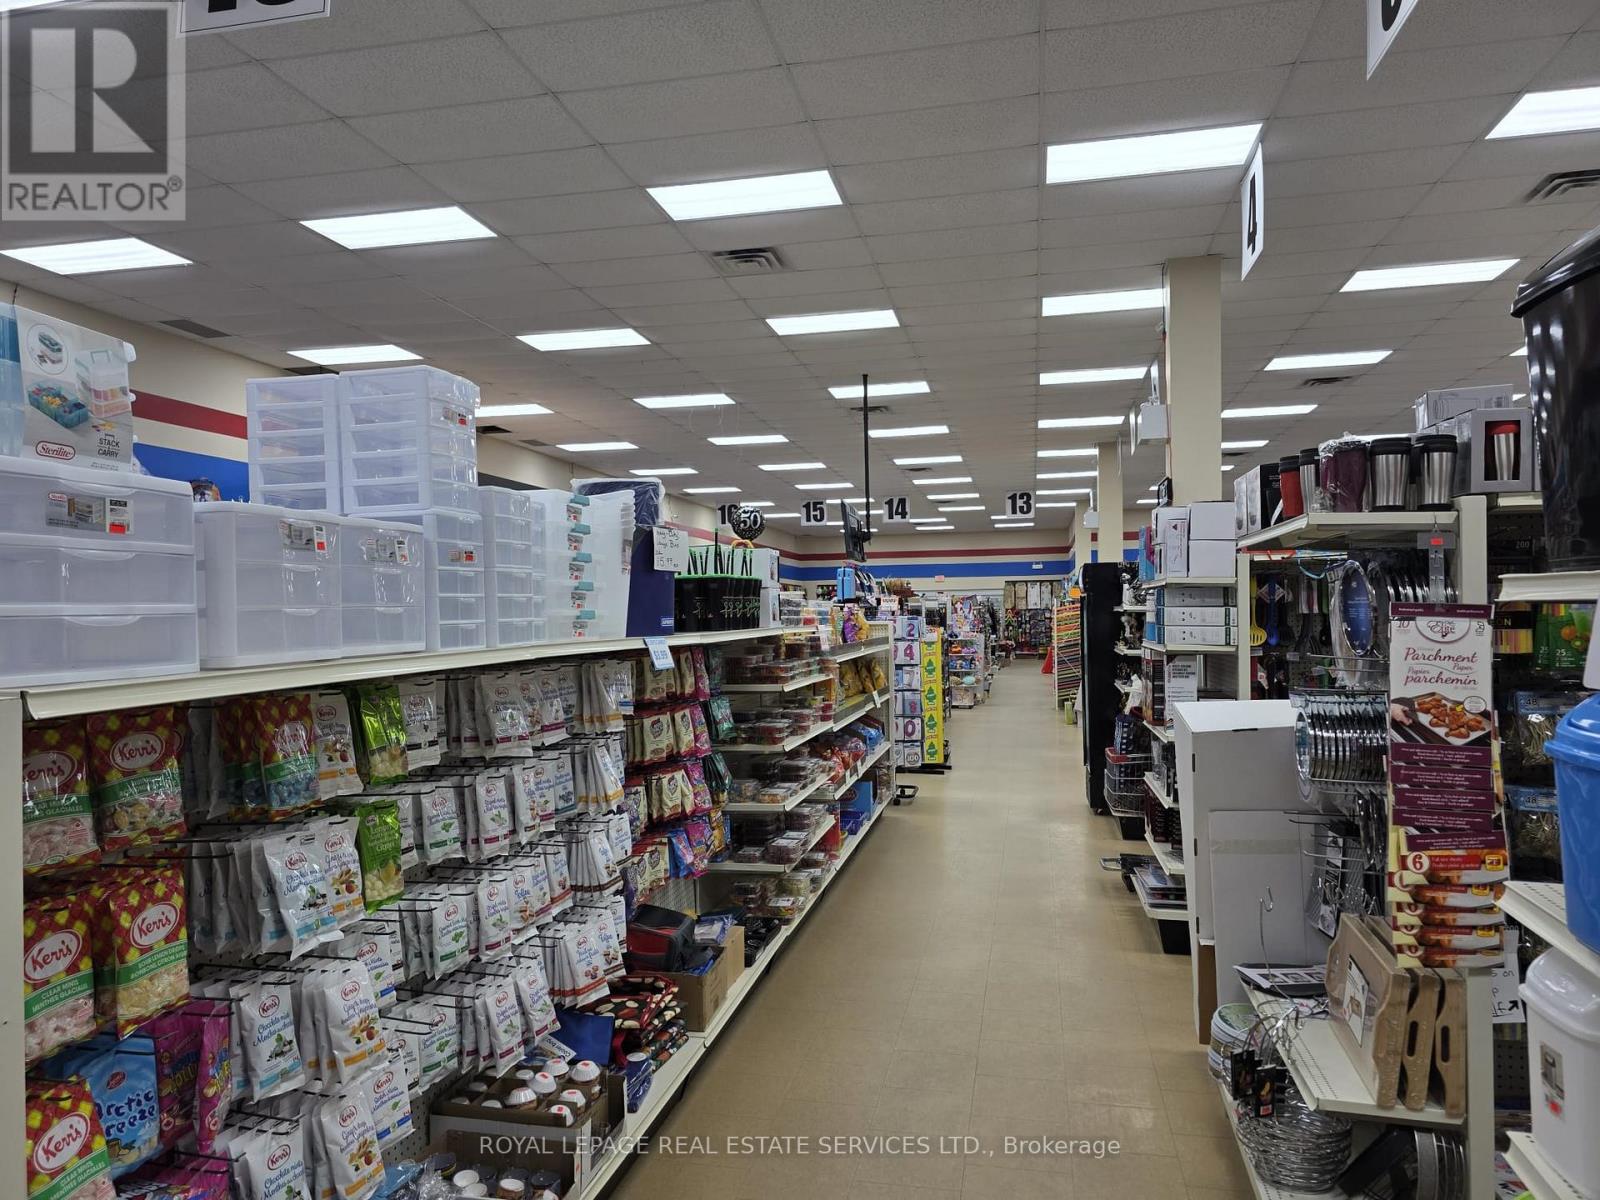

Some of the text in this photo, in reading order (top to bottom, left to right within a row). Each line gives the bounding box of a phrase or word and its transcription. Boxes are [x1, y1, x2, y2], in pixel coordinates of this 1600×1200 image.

[1247, 172, 1258, 255] 4
[38, 443, 72, 458] Sterilite
[99, 438, 120, 448] STACK
[98, 448, 118, 458] CARRY
[884, 498, 907, 520] 14
[1008, 492, 1032, 514] 13
[740, 511, 761, 529] 50
[803, 501, 825, 523] 15
[907, 623, 915, 637] 2
[904, 644, 915, 660] 4
[1404, 647, 1479, 663] Parchment
[1556, 648, 1566, 656] 25
[1403, 671, 1478, 686] parchemin
[904, 719, 916, 737] 0
[118, 739, 157, 761] Kerr's
[1412, 854, 1423, 871] 6
[137, 911, 172, 940] Kerr's
[31, 939, 73, 973] Kerr's
[41, 985, 61, 1000] CLEAR
[261, 998, 278, 1014] Kerr's
[41, 1124, 82, 1162] Kerr's
[269, 1147, 289, 1167] Kerr's
[60, 1171, 78, 1187] CLEAR
[264, 1166, 290, 1189] Chocolate
